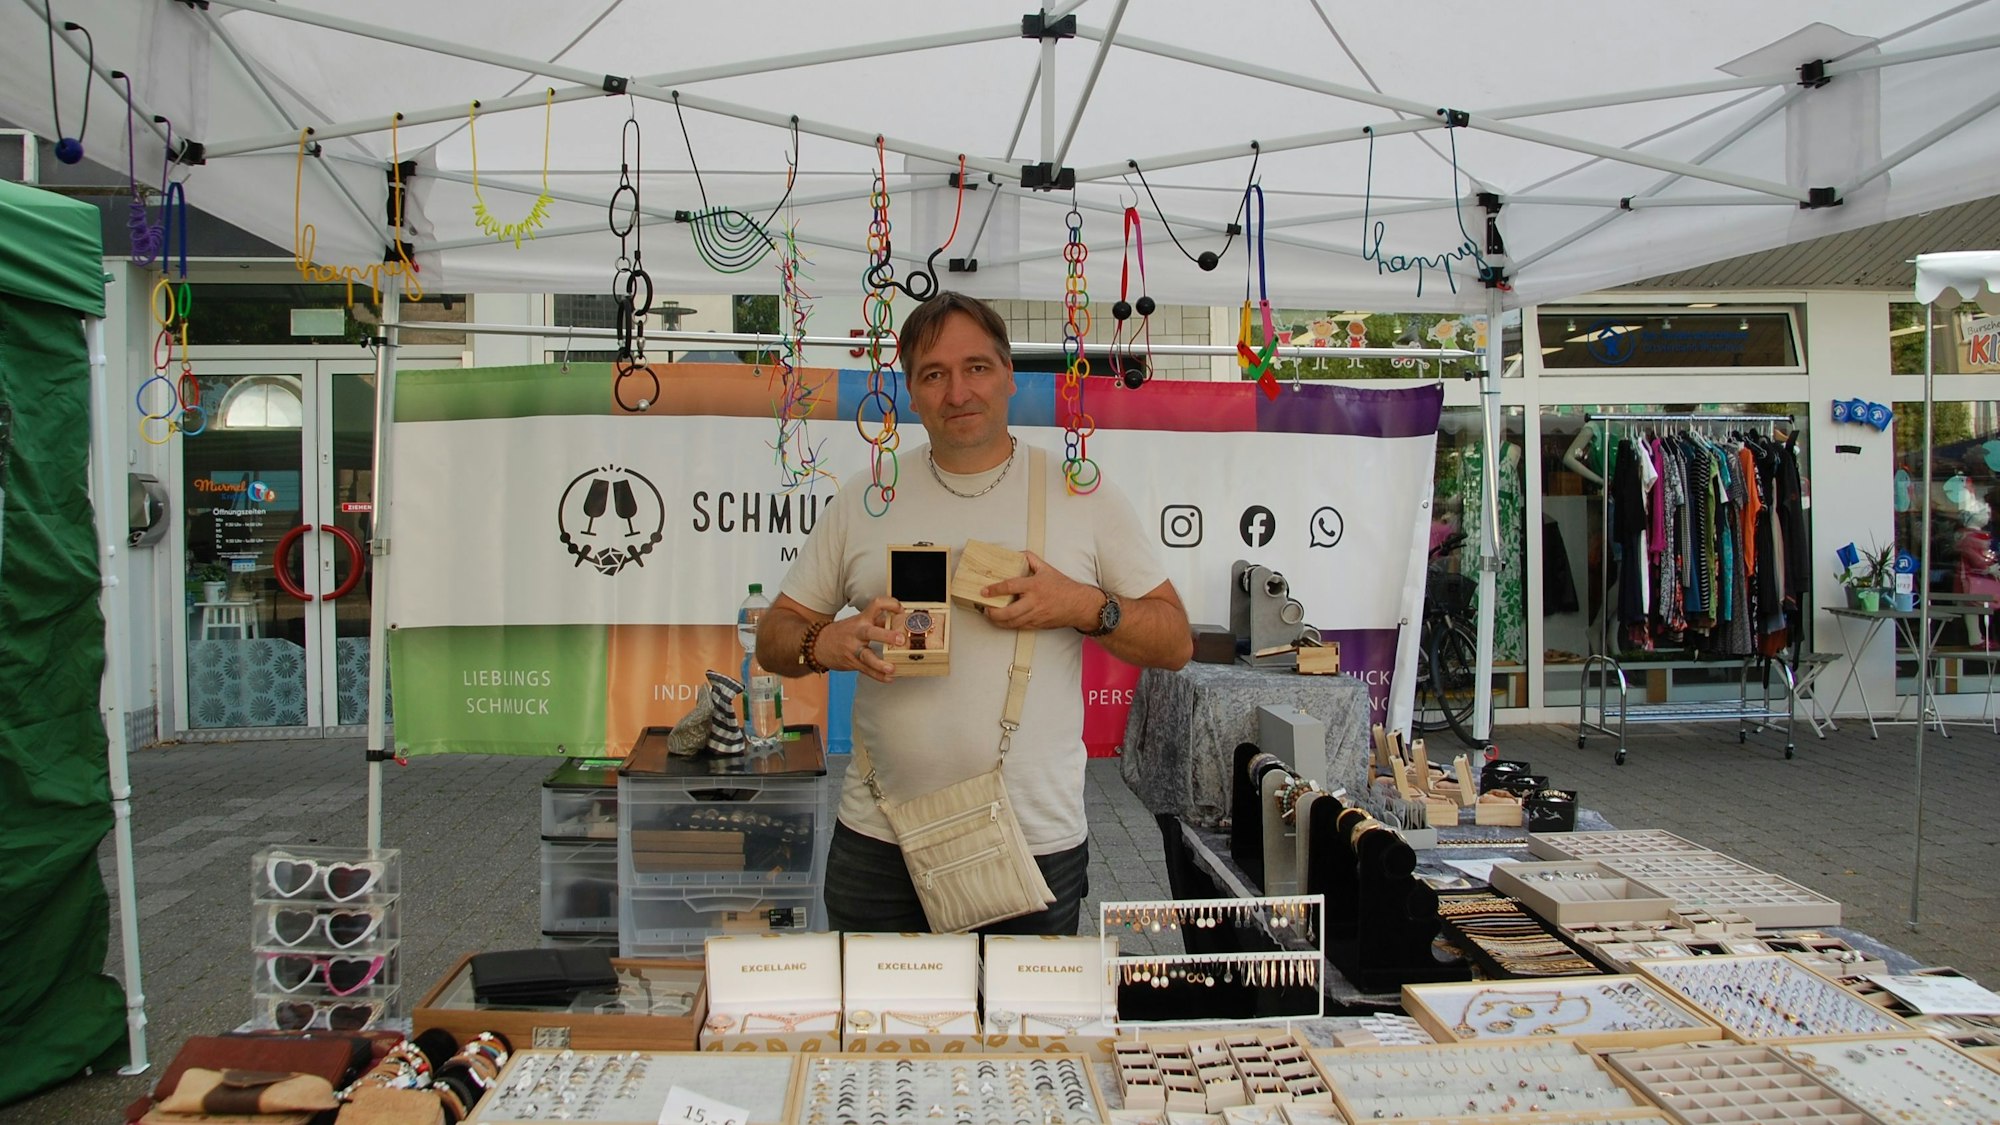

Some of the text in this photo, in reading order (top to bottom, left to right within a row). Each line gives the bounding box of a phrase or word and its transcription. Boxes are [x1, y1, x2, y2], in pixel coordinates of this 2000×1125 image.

[300, 224, 423, 308] happy
[1371, 221, 1493, 297] happy
[1971, 334, 2000, 363] KI
[194, 479, 247, 492] Murmel
[212, 507, 267, 517] Öffnungszeiten
[692, 491, 834, 535] SCHMU
[463, 670, 551, 687] LIEBLINGS
[1346, 670, 1391, 686] UCK
[466, 697, 549, 715] SCHMUCK
[1088, 689, 1134, 706] PERS
[741, 962, 807, 973] EXCELLANC
[877, 962, 943, 971] EXCELLANC
[1017, 964, 1084, 973] EXCELLANC
